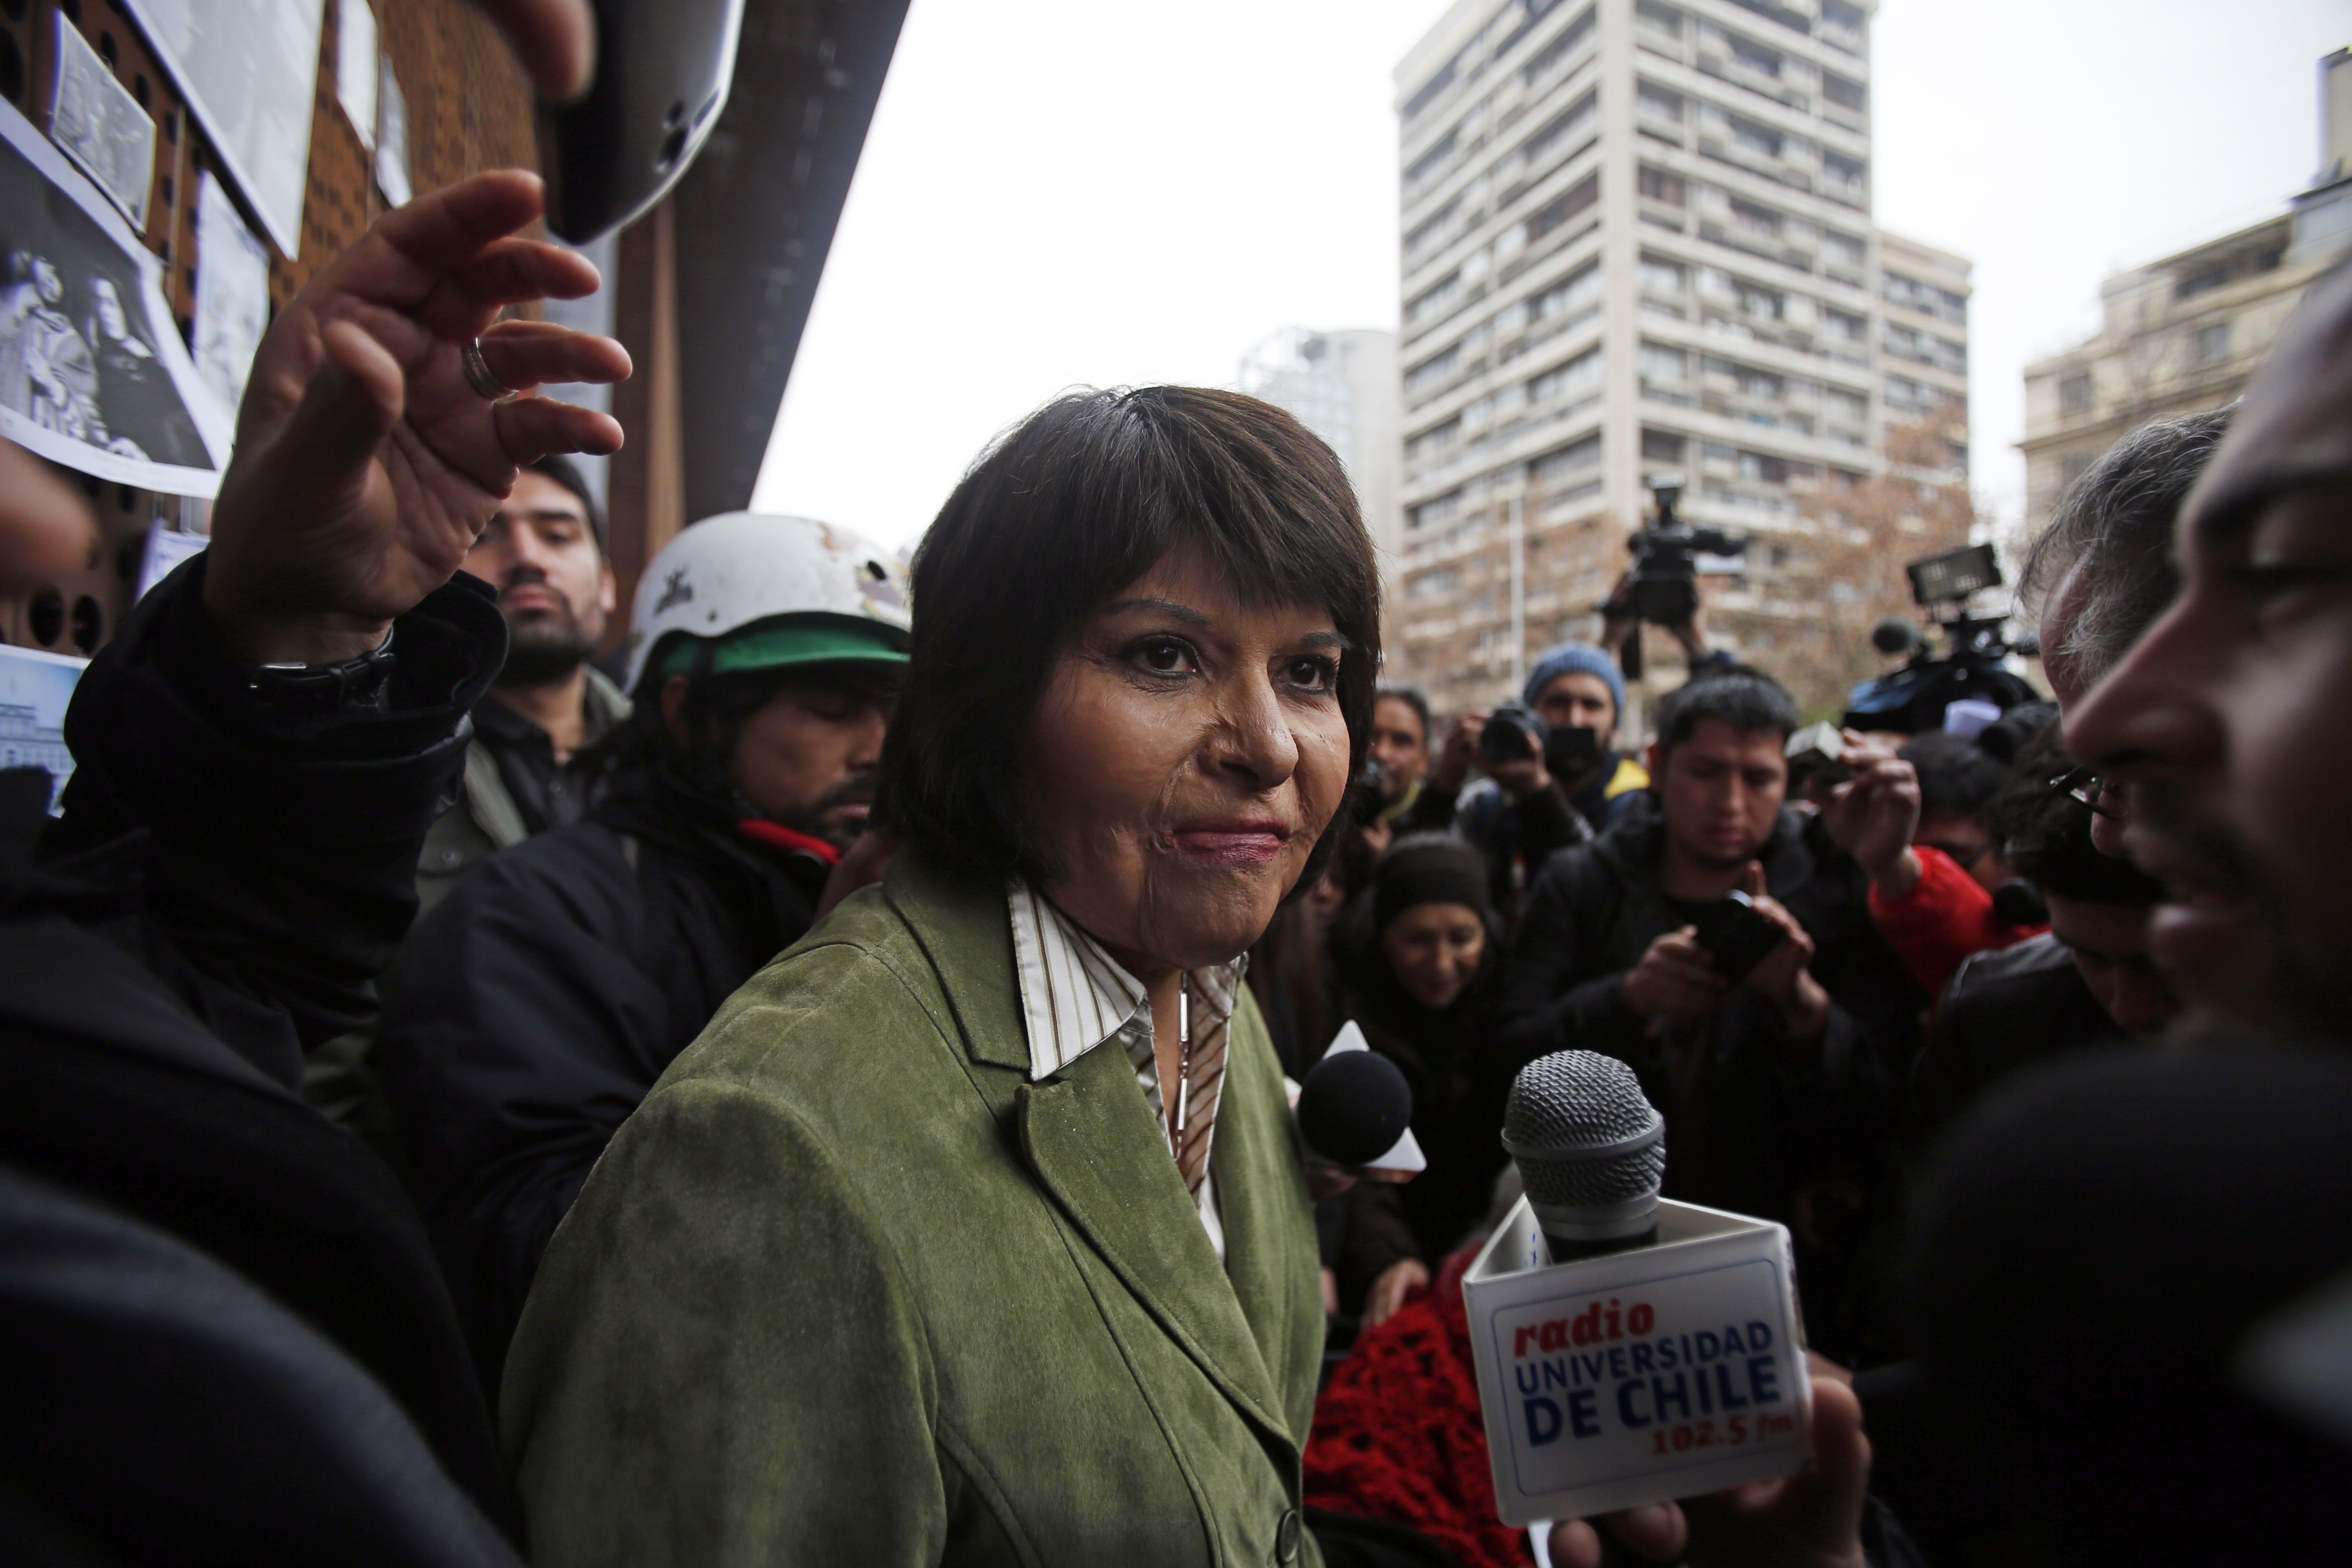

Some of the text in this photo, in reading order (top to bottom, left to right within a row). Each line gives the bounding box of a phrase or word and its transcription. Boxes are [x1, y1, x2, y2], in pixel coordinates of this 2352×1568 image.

[1514, 1298, 1655, 1357] radio
[1515, 1321, 1772, 1395] UNIVERSIDAD
[1525, 1357, 1780, 1447] DE CHILE
[1653, 1415, 1747, 1455] 102.5
